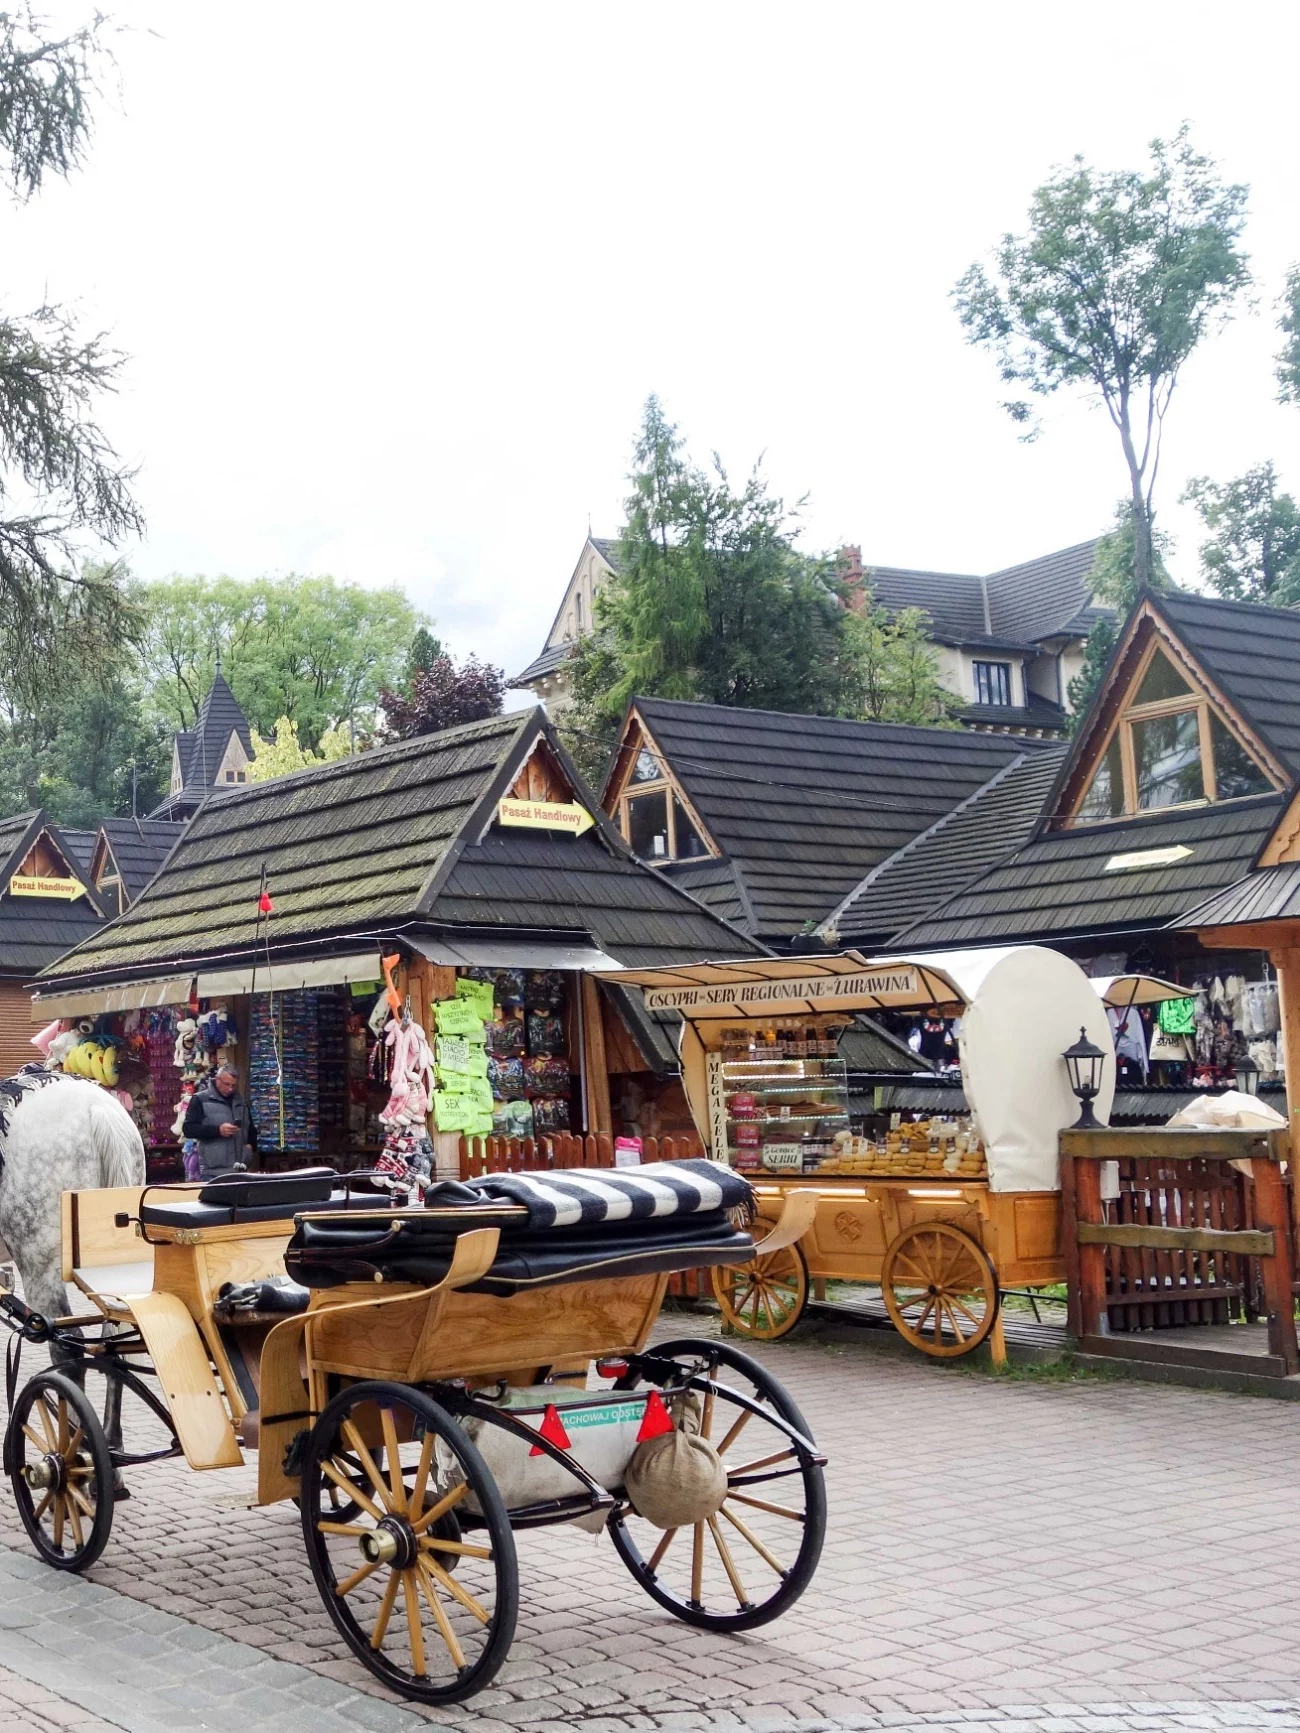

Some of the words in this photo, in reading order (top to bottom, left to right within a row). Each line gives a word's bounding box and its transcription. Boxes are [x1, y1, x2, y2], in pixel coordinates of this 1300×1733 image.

[501, 804, 532, 819] Pasaż
[533, 807, 582, 826] Handlowy
[12, 880, 36, 890] Pasaż
[37, 882, 77, 894] Handlowy
[649, 990, 698, 1007] OSCYPKI
[706, 987, 738, 1003] SERY
[740, 981, 826, 1002] REGIONALNE
[834, 975, 911, 996] ŻURAWINA
[708, 1062, 721, 1108] MEGA
[445, 1098, 460, 1110] SEX
[768, 1154, 798, 1164] SERKI
[562, 1411, 610, 1425] ACHOWAJ
